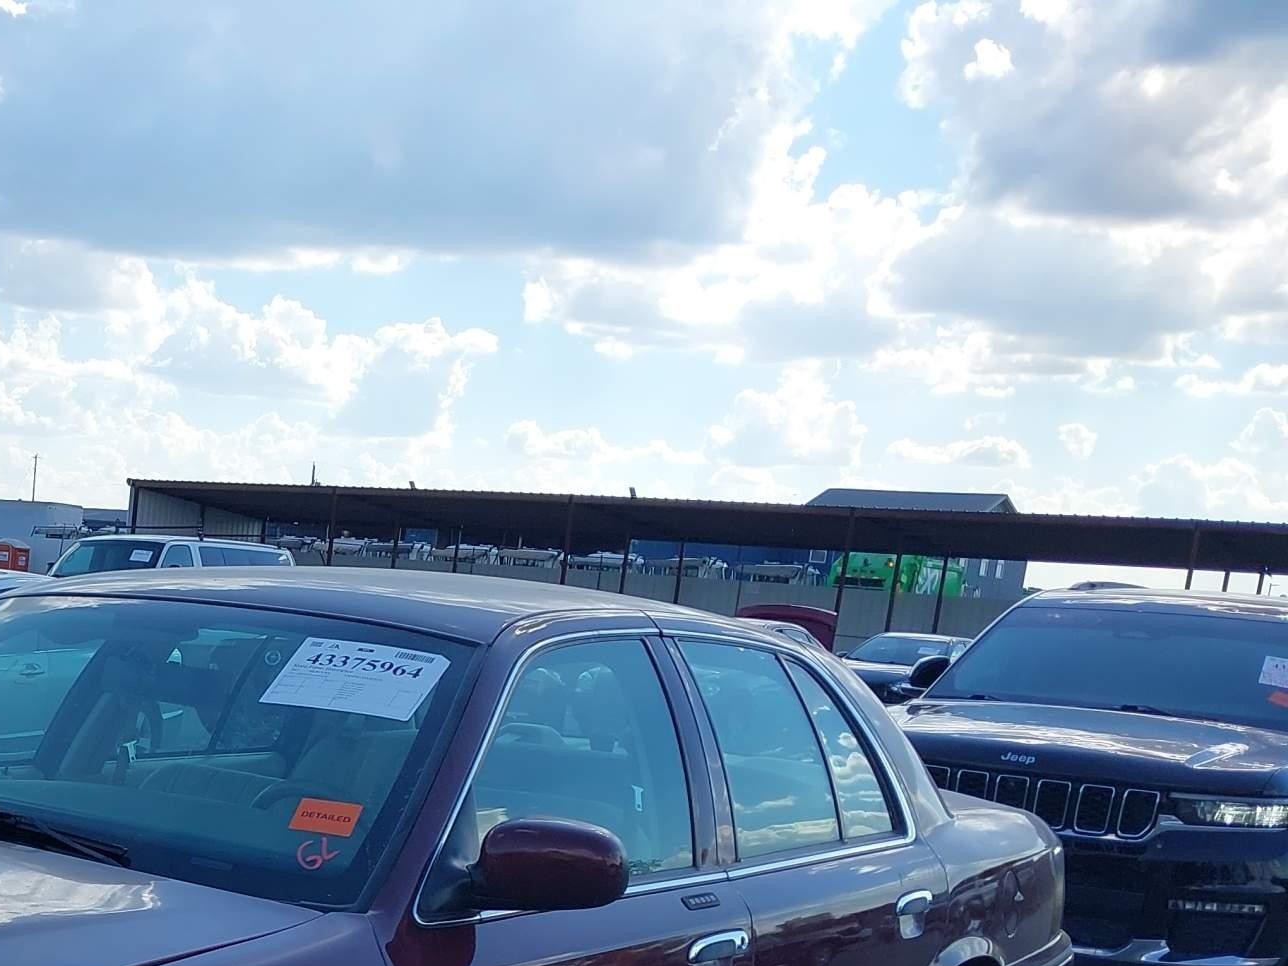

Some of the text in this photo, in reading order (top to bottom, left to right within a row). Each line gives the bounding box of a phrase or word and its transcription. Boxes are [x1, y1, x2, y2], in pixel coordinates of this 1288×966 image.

[306, 652, 425, 679] 43375964
[1000, 751, 1037, 766] Jeep
[300, 810, 353, 823] DETAILED
